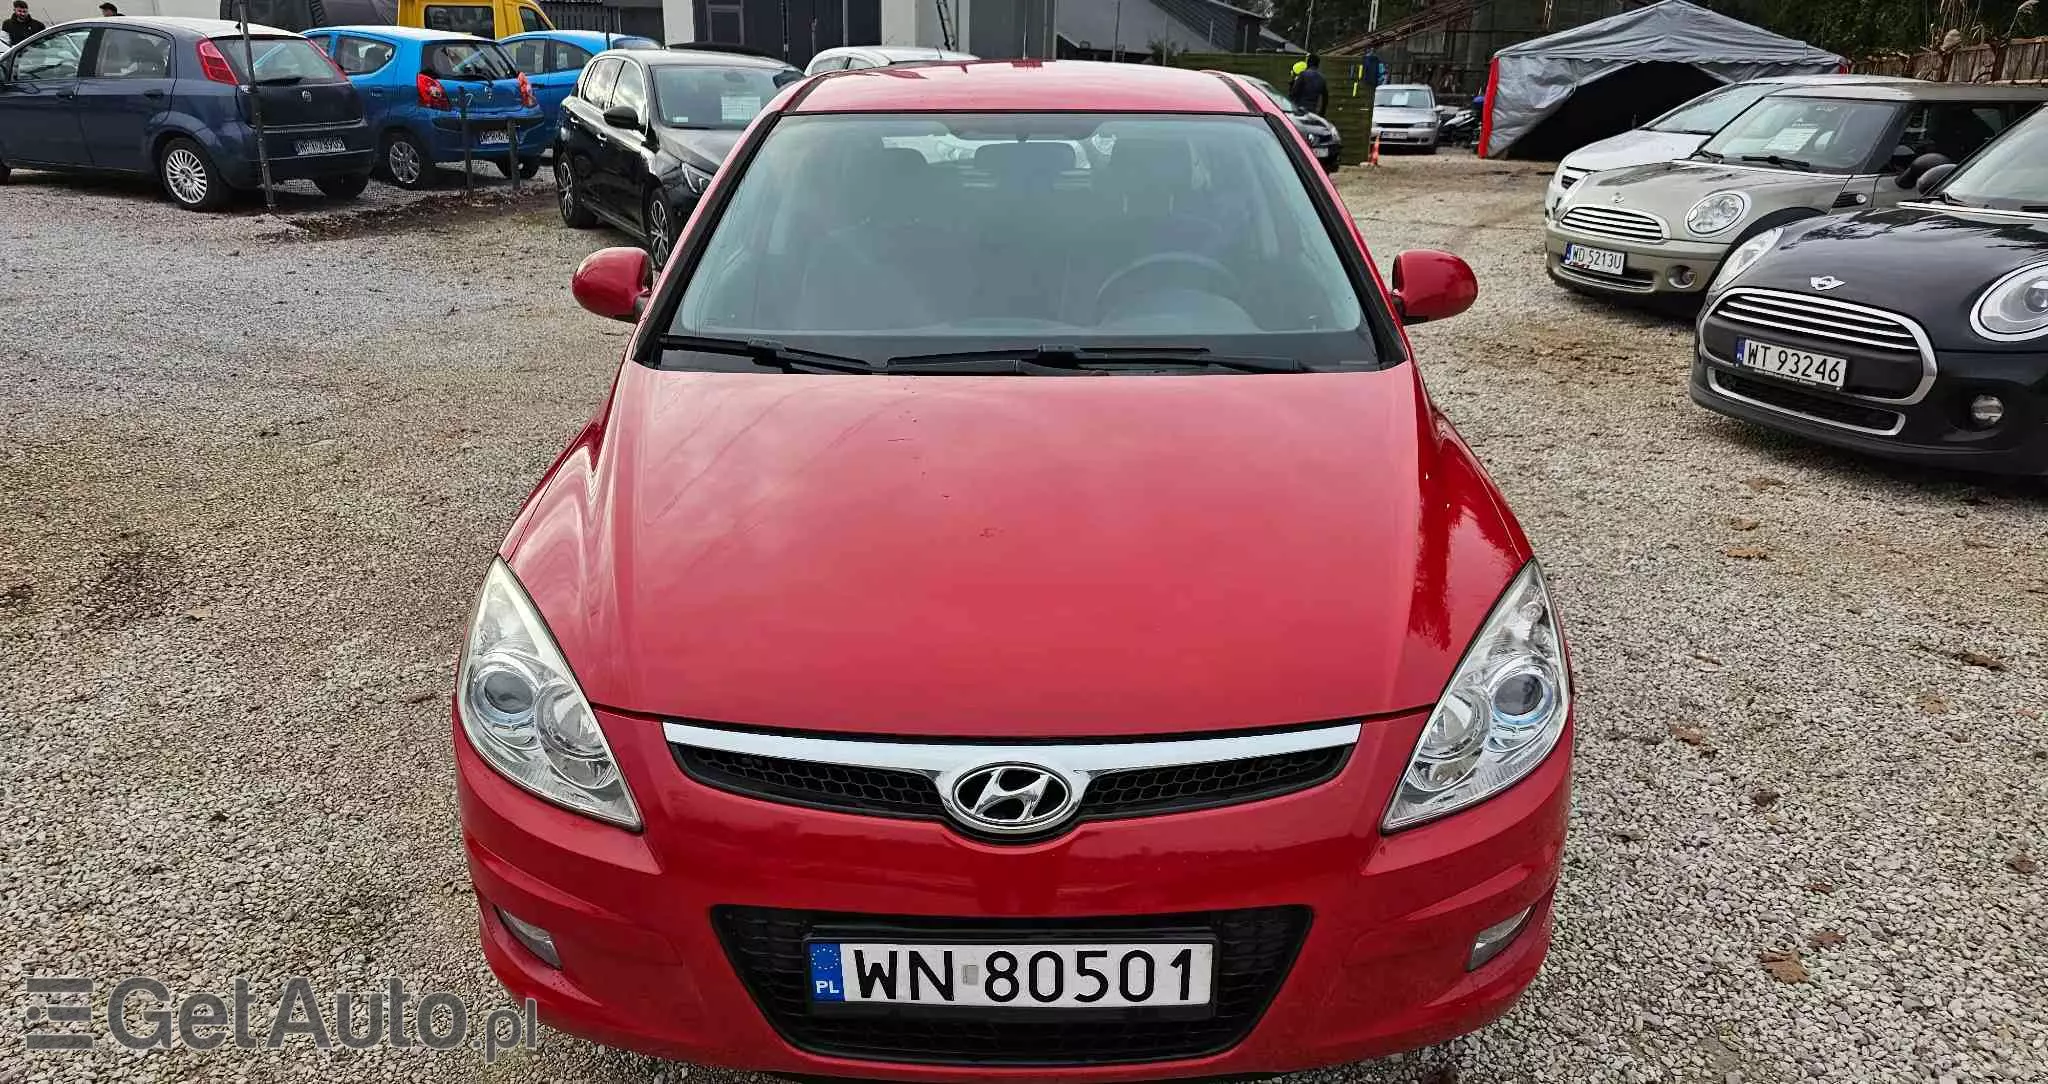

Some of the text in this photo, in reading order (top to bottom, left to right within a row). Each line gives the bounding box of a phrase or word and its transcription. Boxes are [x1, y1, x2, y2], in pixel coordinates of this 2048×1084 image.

[1588, 250, 1622, 269] 5213U
[1748, 343, 1771, 367] WT
[1777, 350, 1841, 382] 93246
[815, 980, 840, 994] PL
[854, 949, 1192, 1002] WN 80501
